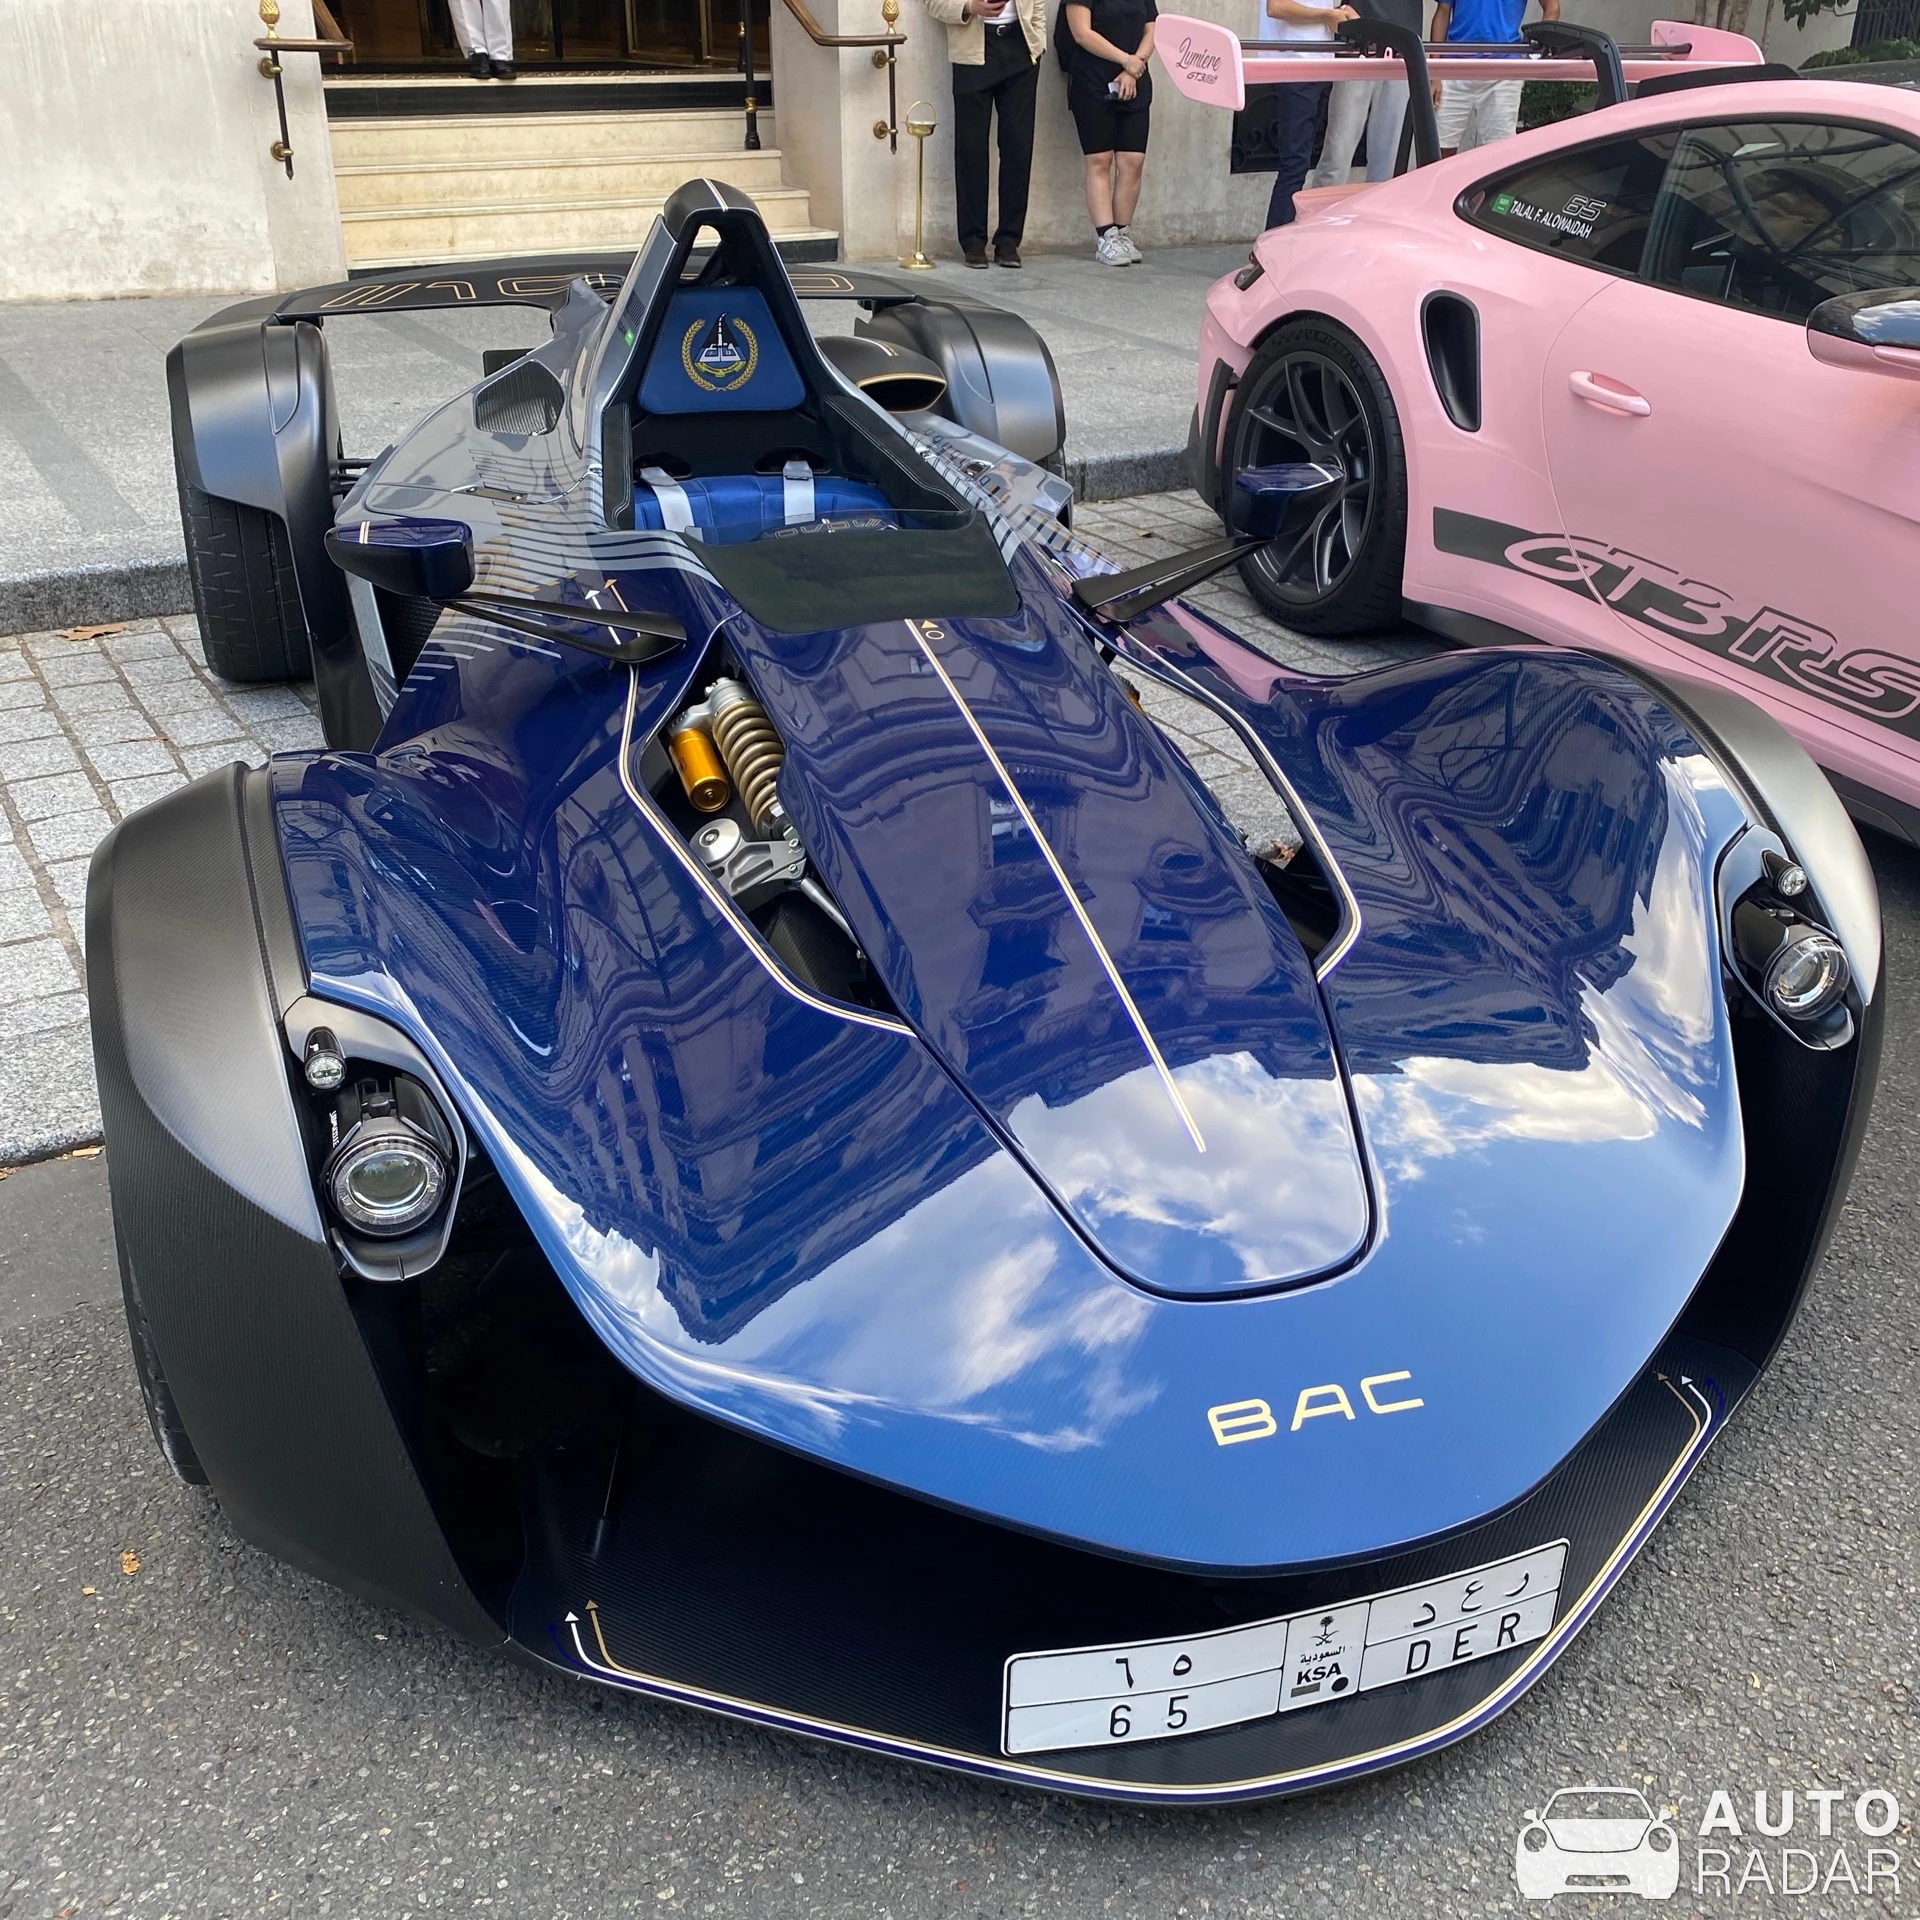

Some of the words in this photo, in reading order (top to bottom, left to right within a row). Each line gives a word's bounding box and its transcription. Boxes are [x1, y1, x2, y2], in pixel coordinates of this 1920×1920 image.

[1510, 200, 1533, 220] TALAL
[1540, 212, 1593, 239] ALOWAIDAH
[1562, 194, 1607, 221] 65
[1207, 1370, 1425, 1446] BAC
[1300, 1645, 1346, 1666] السعودية
[1296, 1662, 1342, 1686] KSA
